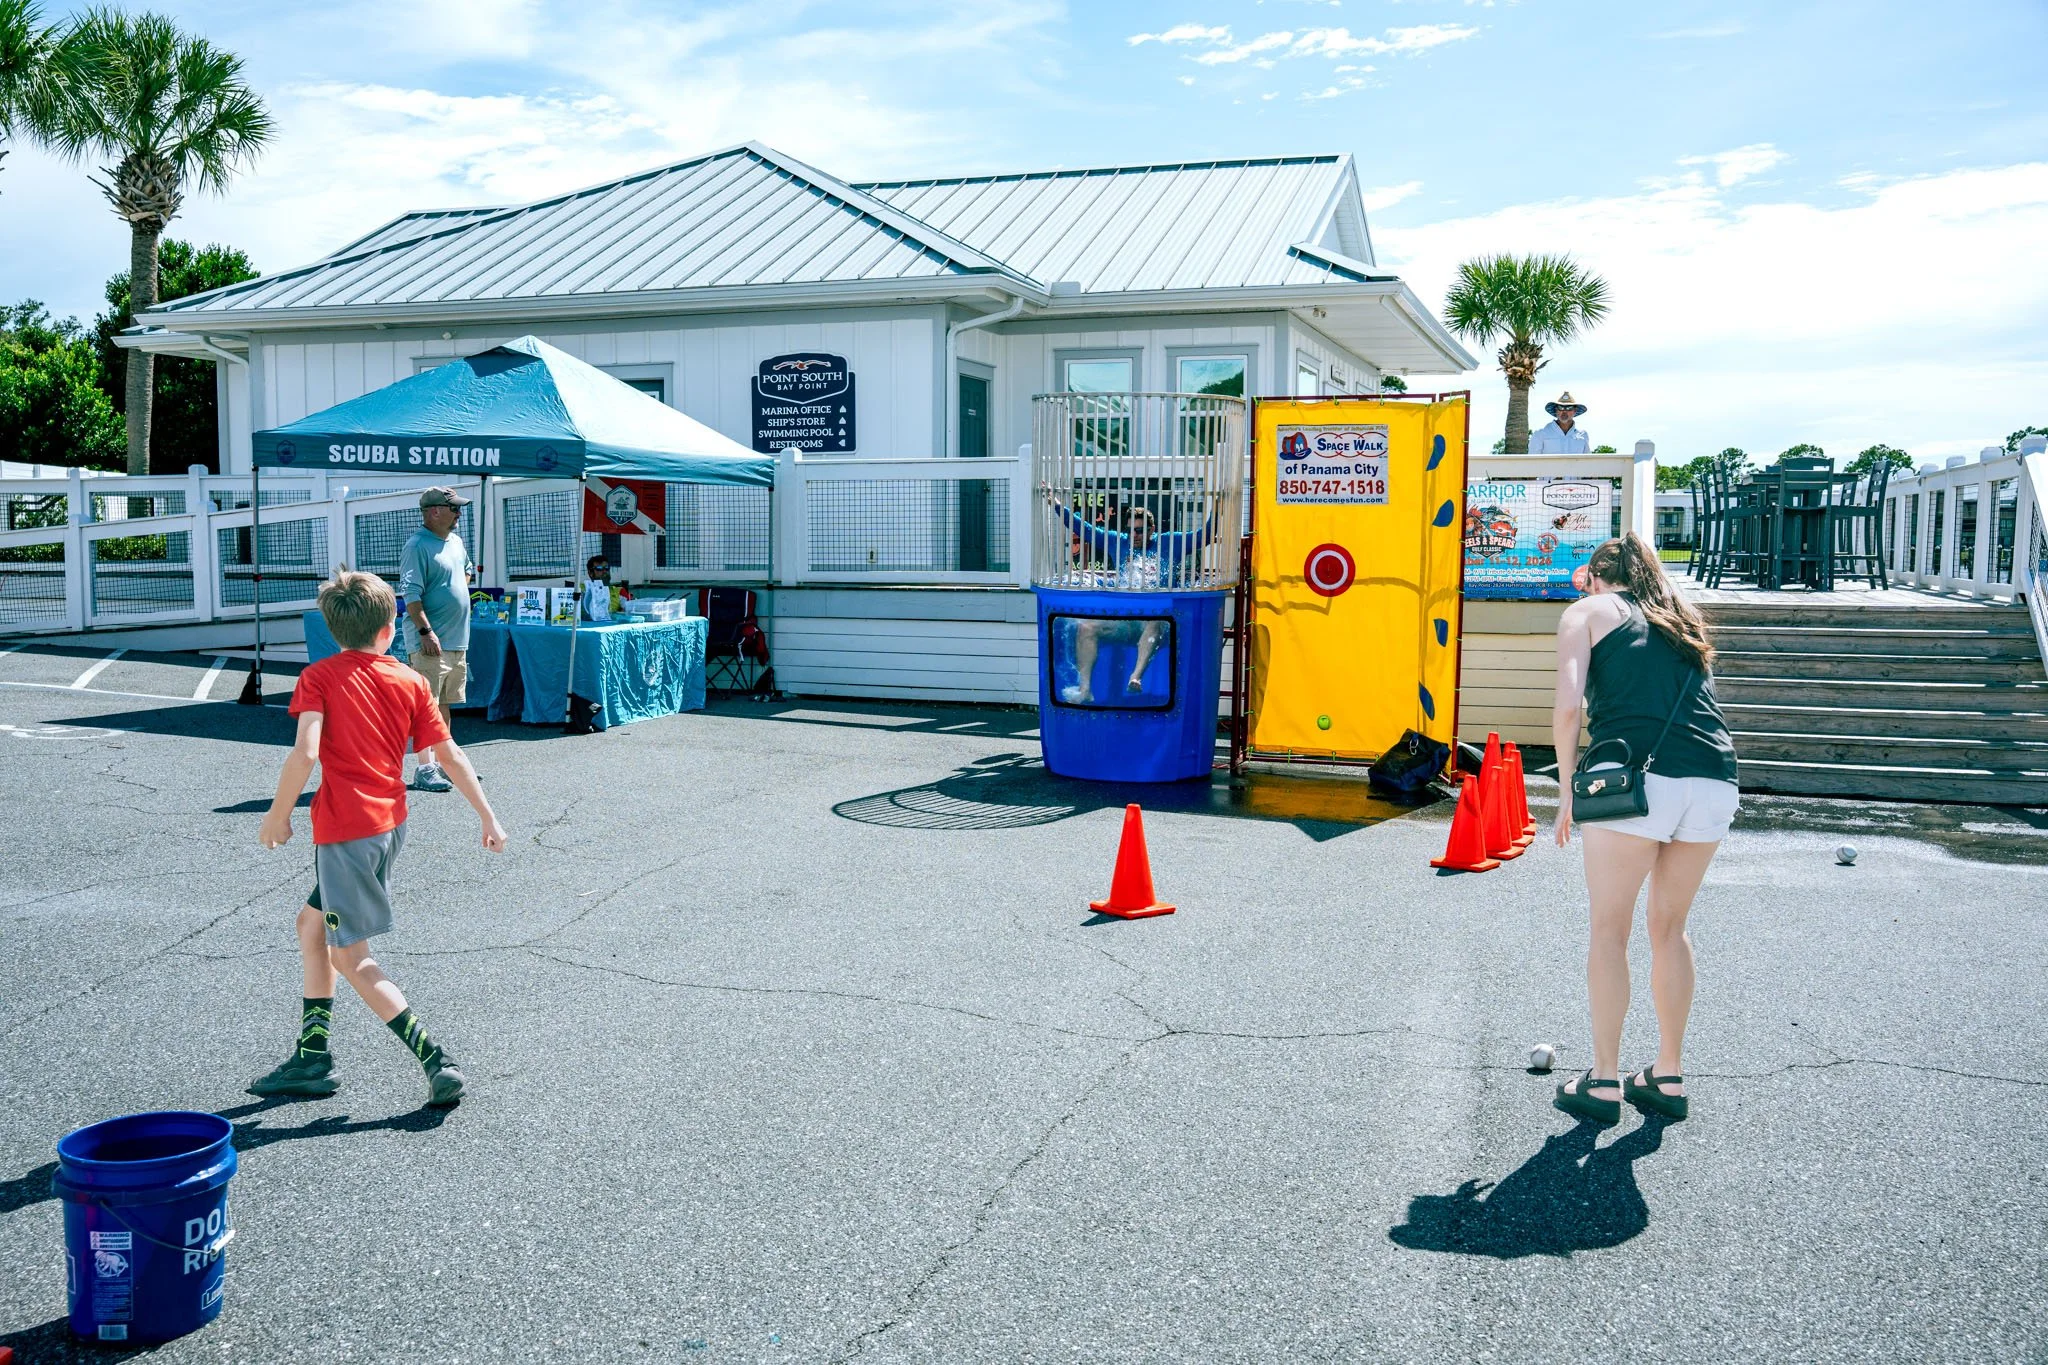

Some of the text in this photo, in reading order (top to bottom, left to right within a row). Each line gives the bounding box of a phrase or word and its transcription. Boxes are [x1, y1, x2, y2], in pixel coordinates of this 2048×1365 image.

[762, 372, 843, 384] POINT SOUTH
[777, 382, 828, 391] BAY POINT
[761, 405, 832, 416] MARINA OFFICE
[767, 417, 826, 427] SHIP'S STORE
[758, 428, 834, 438] SWIMMING POOL
[769, 439, 824, 449] RESTROOMS
[1317, 438, 1383, 451] SPACE WALK
[328, 444, 501, 467] SCUBA STATION
[1285, 463, 1379, 478] of Panama City
[1279, 479, 1385, 495] 850-747-1518
[1467, 484, 1526, 500] ARRIOR
[1465, 536, 1481, 548] EELS
[1489, 535, 1516, 549] SPEARS
[525, 590, 539, 600] TRY
[185, 1208, 221, 1247] DO
